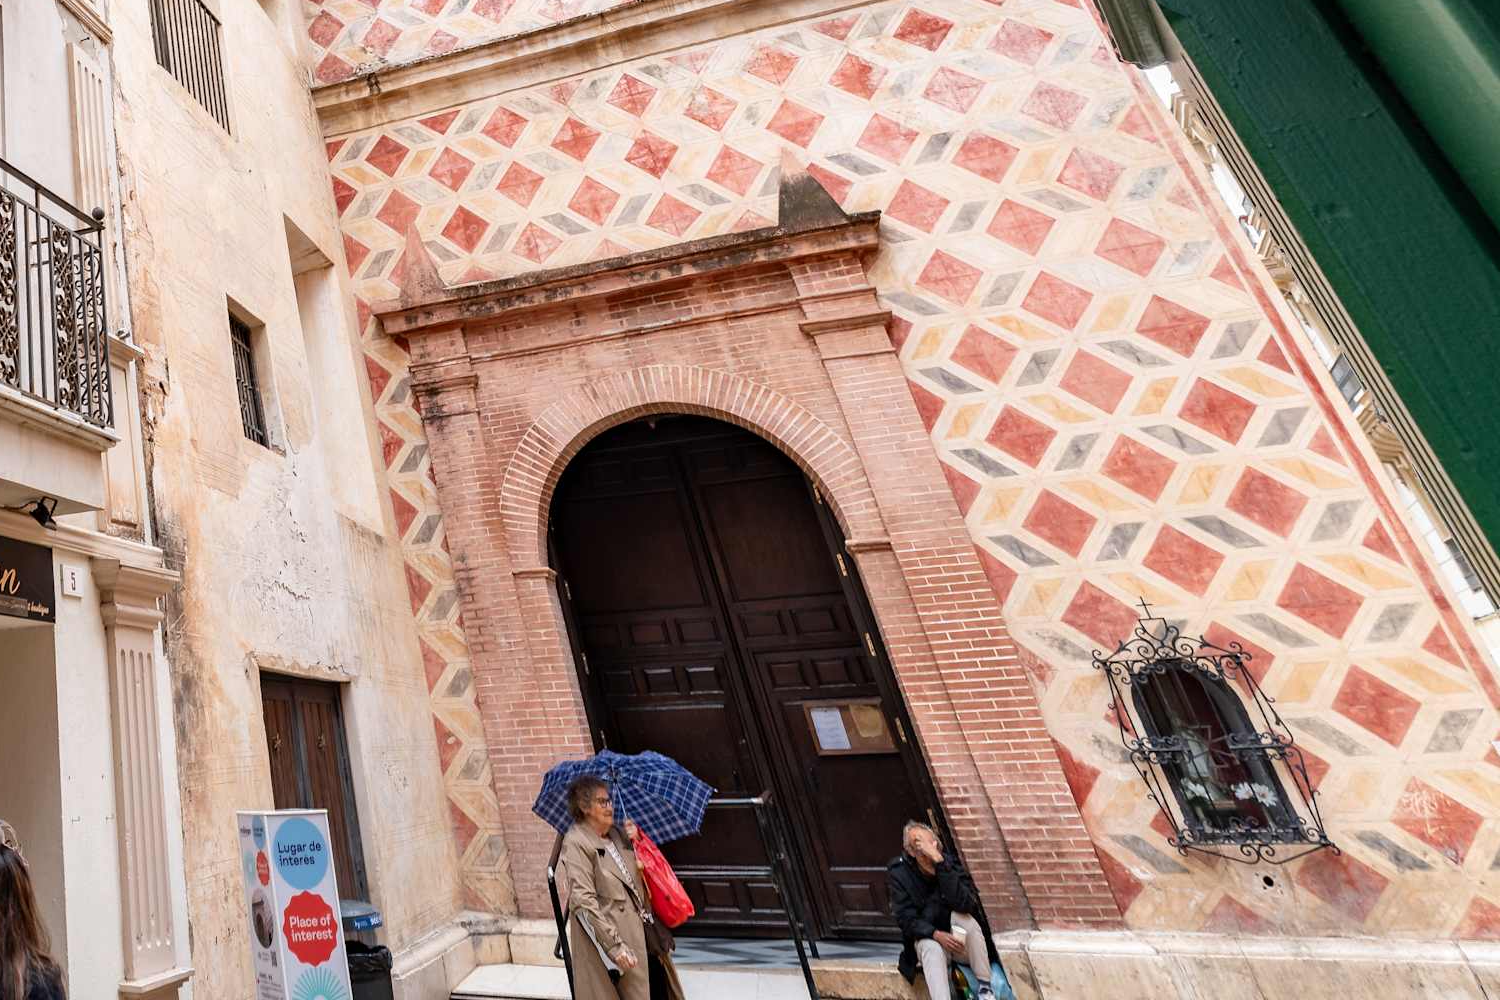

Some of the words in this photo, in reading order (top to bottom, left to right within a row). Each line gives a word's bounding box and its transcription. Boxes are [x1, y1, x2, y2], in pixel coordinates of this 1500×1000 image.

[71, 572, 76, 591] 5
[277, 841, 307, 856] Lugar
[309, 840, 322, 852] de
[289, 914, 318, 928] Place
[320, 913, 332, 926] of
[291, 928, 333, 943] interest
